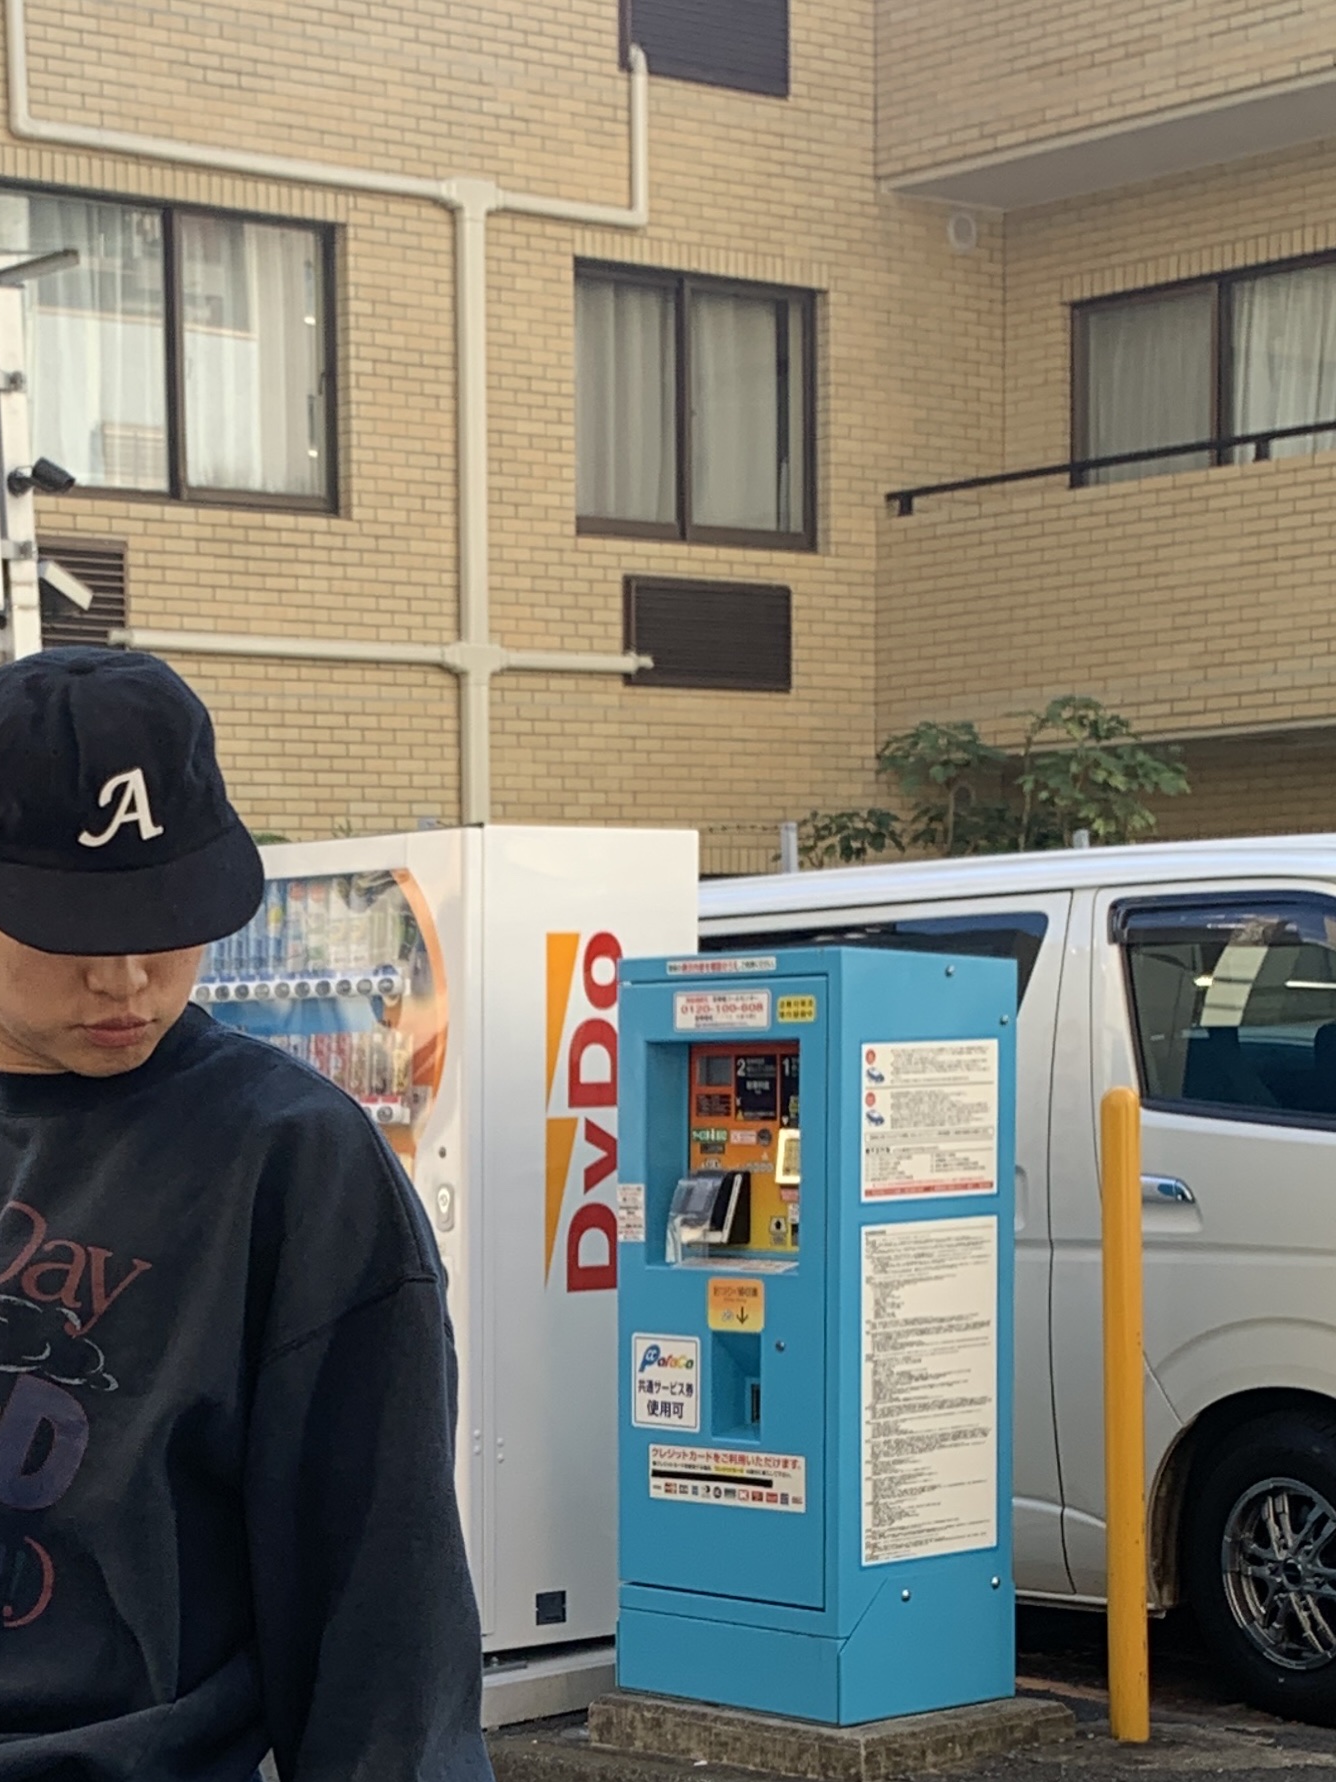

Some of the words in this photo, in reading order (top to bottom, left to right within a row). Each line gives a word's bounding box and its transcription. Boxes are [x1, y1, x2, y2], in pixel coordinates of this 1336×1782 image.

[77, 766, 164, 848] A
[646, 1399, 684, 1420] 使用可
